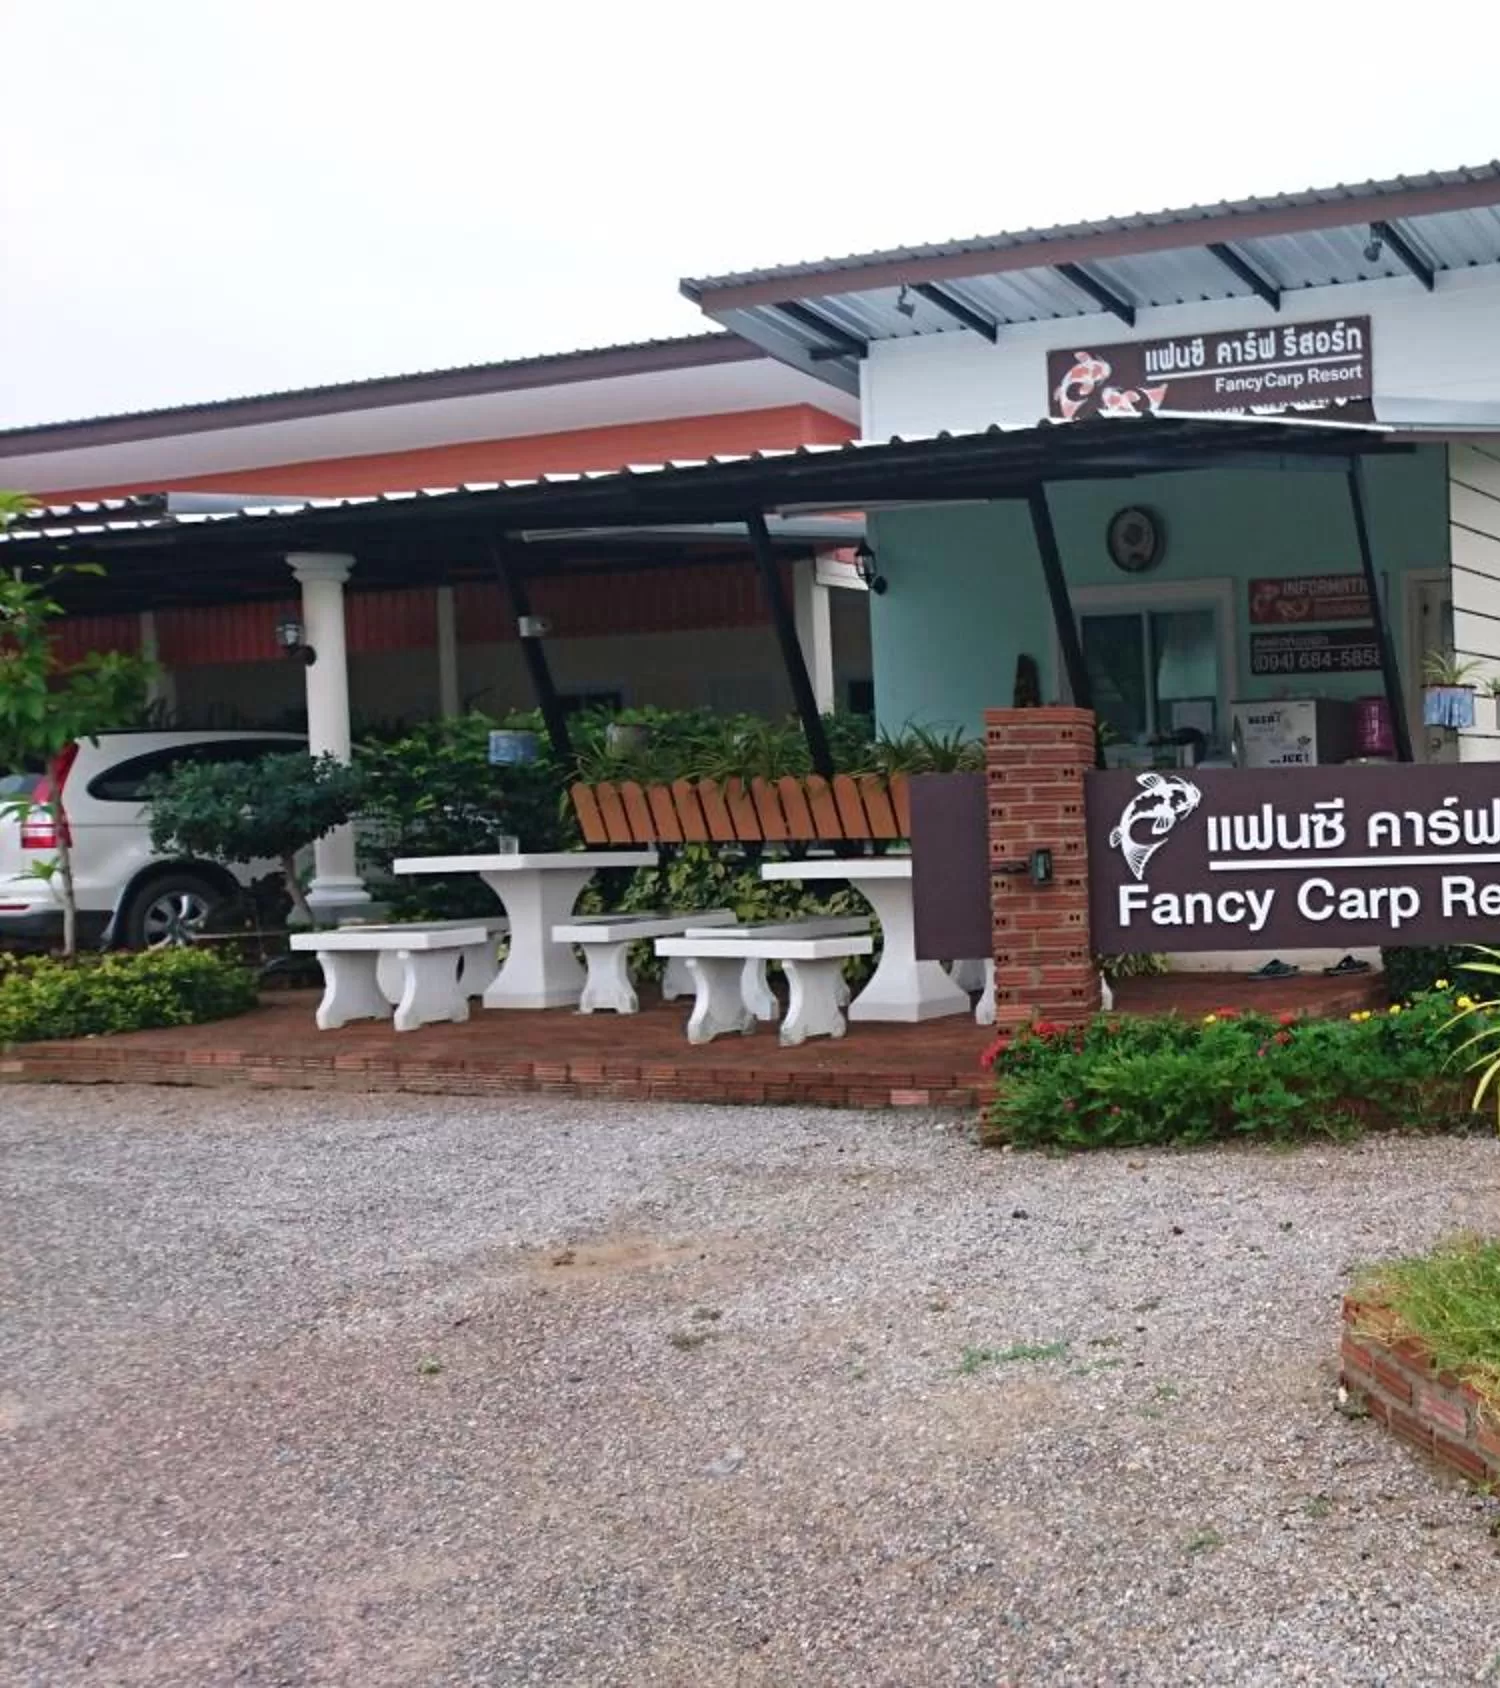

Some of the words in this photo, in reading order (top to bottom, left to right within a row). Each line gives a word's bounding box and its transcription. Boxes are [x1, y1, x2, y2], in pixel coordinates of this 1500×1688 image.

[1284, 322, 1361, 356] รีสอร์ท
[1308, 365, 1362, 384] Resort
[1207, 798, 1346, 851] แฟนซี
[1118, 882, 1275, 932] Fancy
[1297, 877, 1421, 929] Carp
